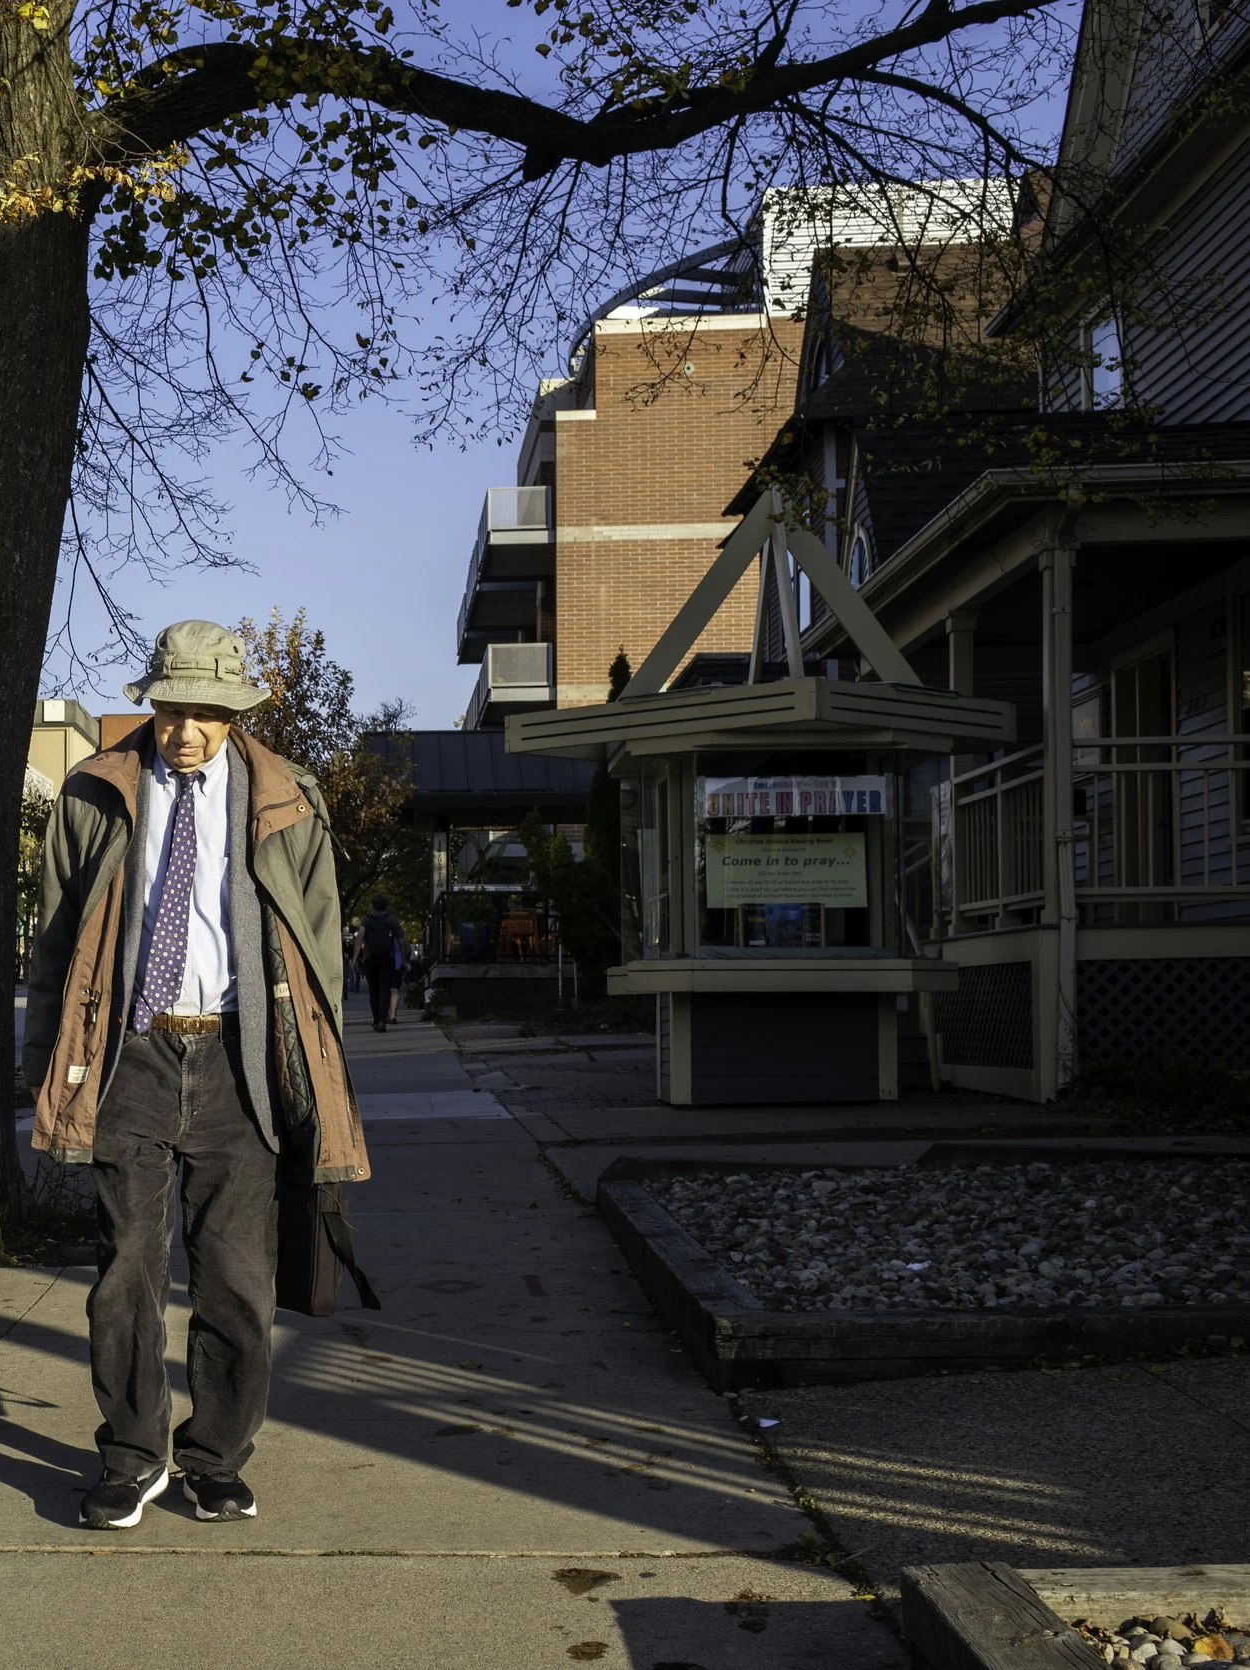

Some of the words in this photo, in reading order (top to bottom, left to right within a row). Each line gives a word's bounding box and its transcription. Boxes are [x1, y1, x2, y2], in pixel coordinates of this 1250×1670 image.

[707, 791, 770, 815] UNITE
[775, 791, 793, 814] IN
[799, 790, 881, 813] PRAYER
[722, 856, 762, 867] Come
[766, 856, 780, 867] in
[784, 856, 799, 867] to
[803, 857, 851, 868] pray...
